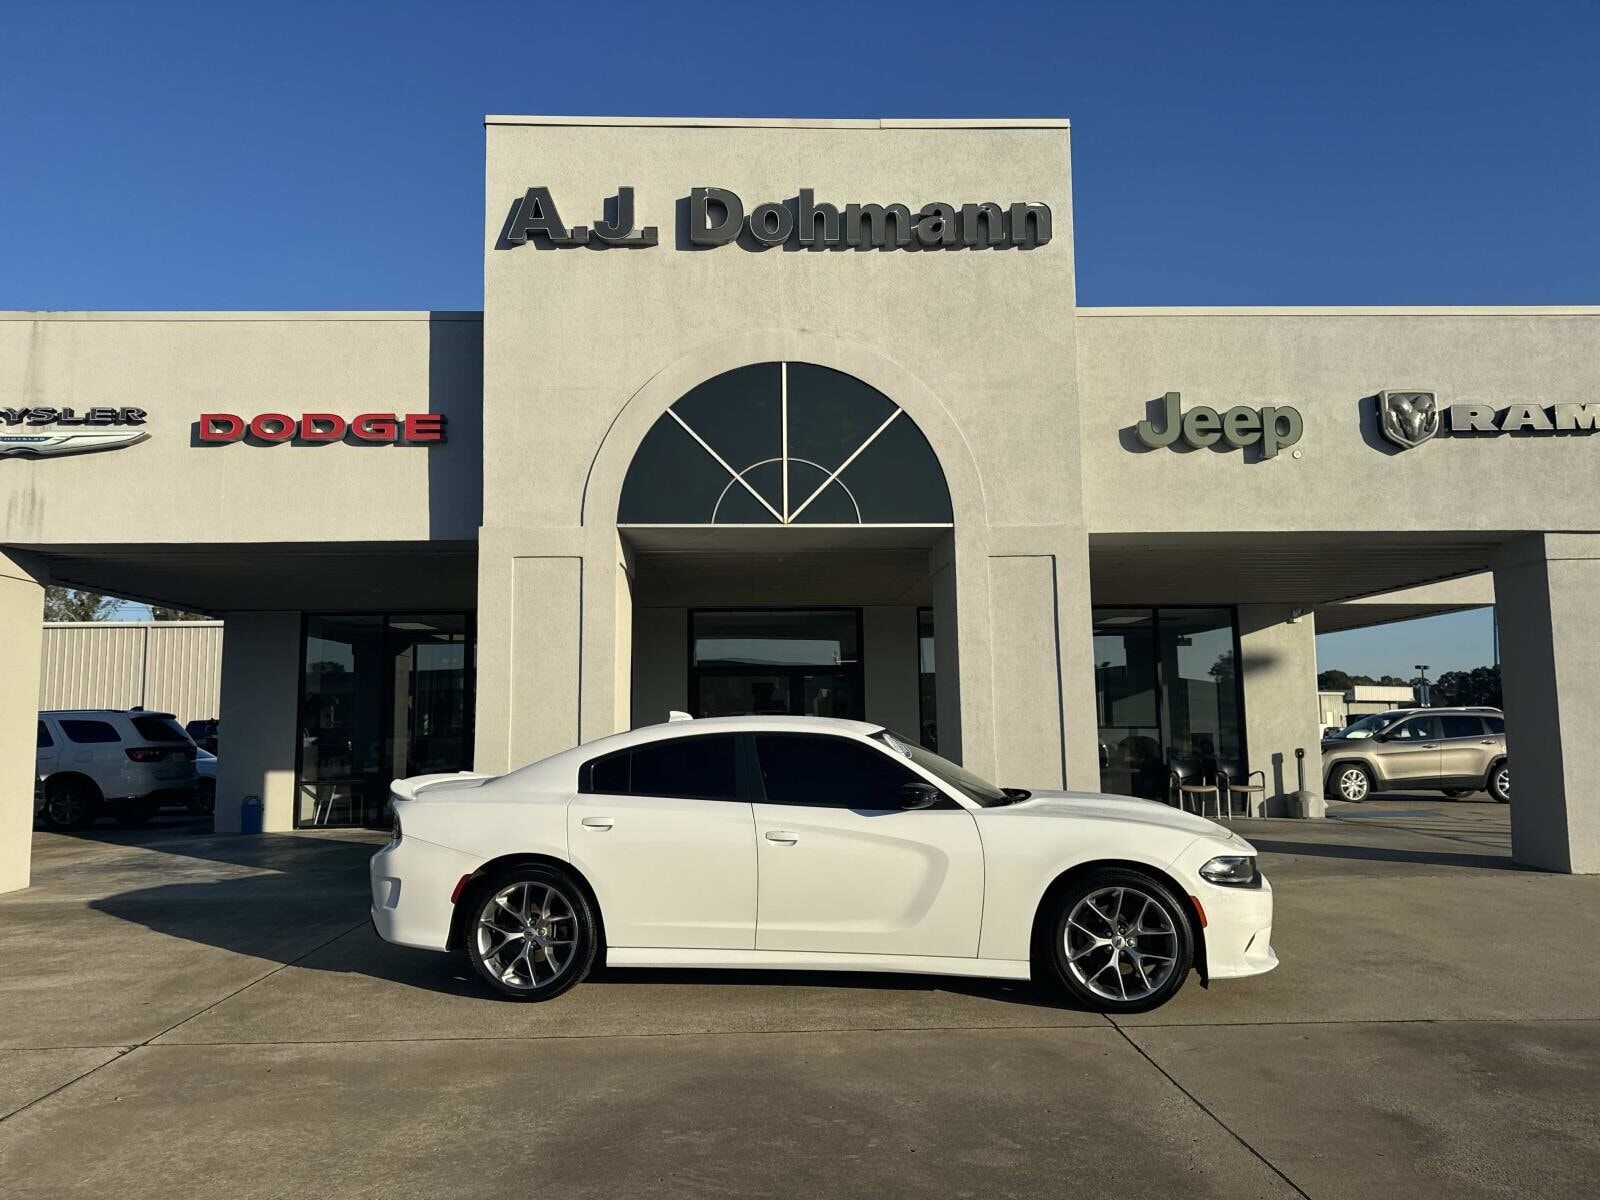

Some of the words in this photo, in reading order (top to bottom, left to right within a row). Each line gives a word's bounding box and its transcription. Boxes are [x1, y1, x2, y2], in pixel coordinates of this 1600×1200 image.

[507, 186, 657, 243] A.J.
[690, 187, 1052, 244] Dohmann
[0, 407, 147, 423] YSLER
[199, 413, 442, 441] DODGE
[1136, 391, 1303, 458] Jeep
[1451, 402, 1600, 431] RAM
